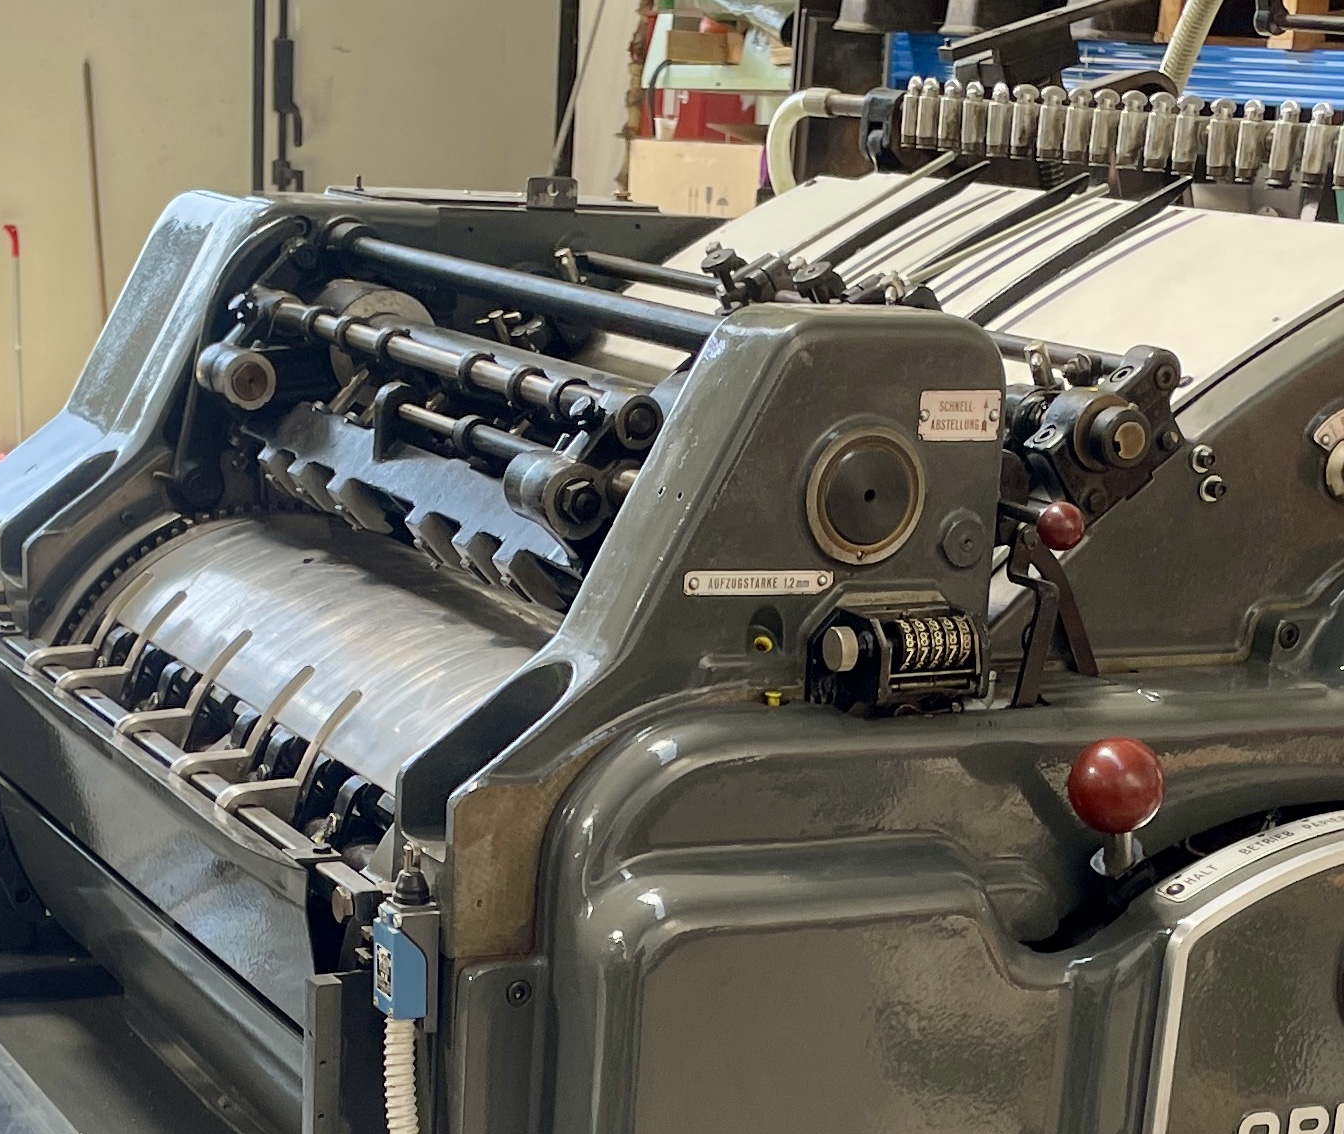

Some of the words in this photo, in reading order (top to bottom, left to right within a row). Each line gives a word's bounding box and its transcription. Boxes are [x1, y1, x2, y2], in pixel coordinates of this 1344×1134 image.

[930, 419, 980, 431] ABSTELLUNG
[1183, 863, 1219, 886] HALT
[1238, 830, 1295, 855] BETRIEB
